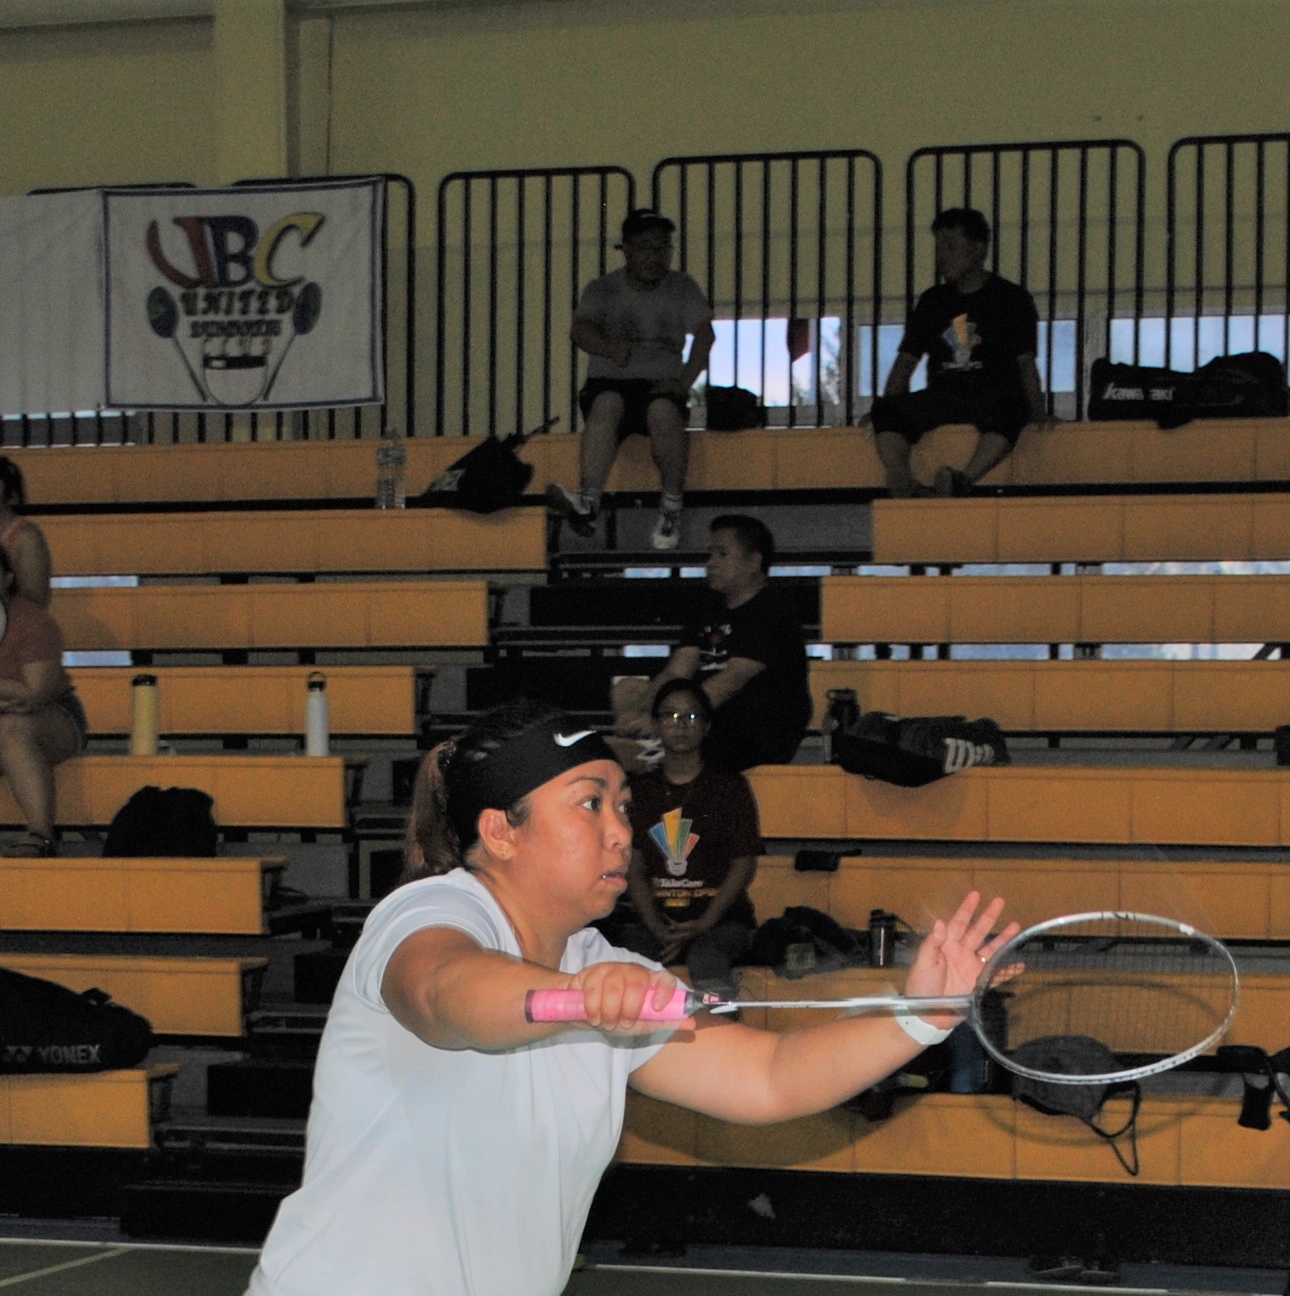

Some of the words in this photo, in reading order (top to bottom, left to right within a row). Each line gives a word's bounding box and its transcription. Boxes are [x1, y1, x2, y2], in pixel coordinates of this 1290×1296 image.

[147, 212, 325, 289] UBC
[180, 288, 296, 316] UNITED
[37, 1044, 102, 1065] YONEX
